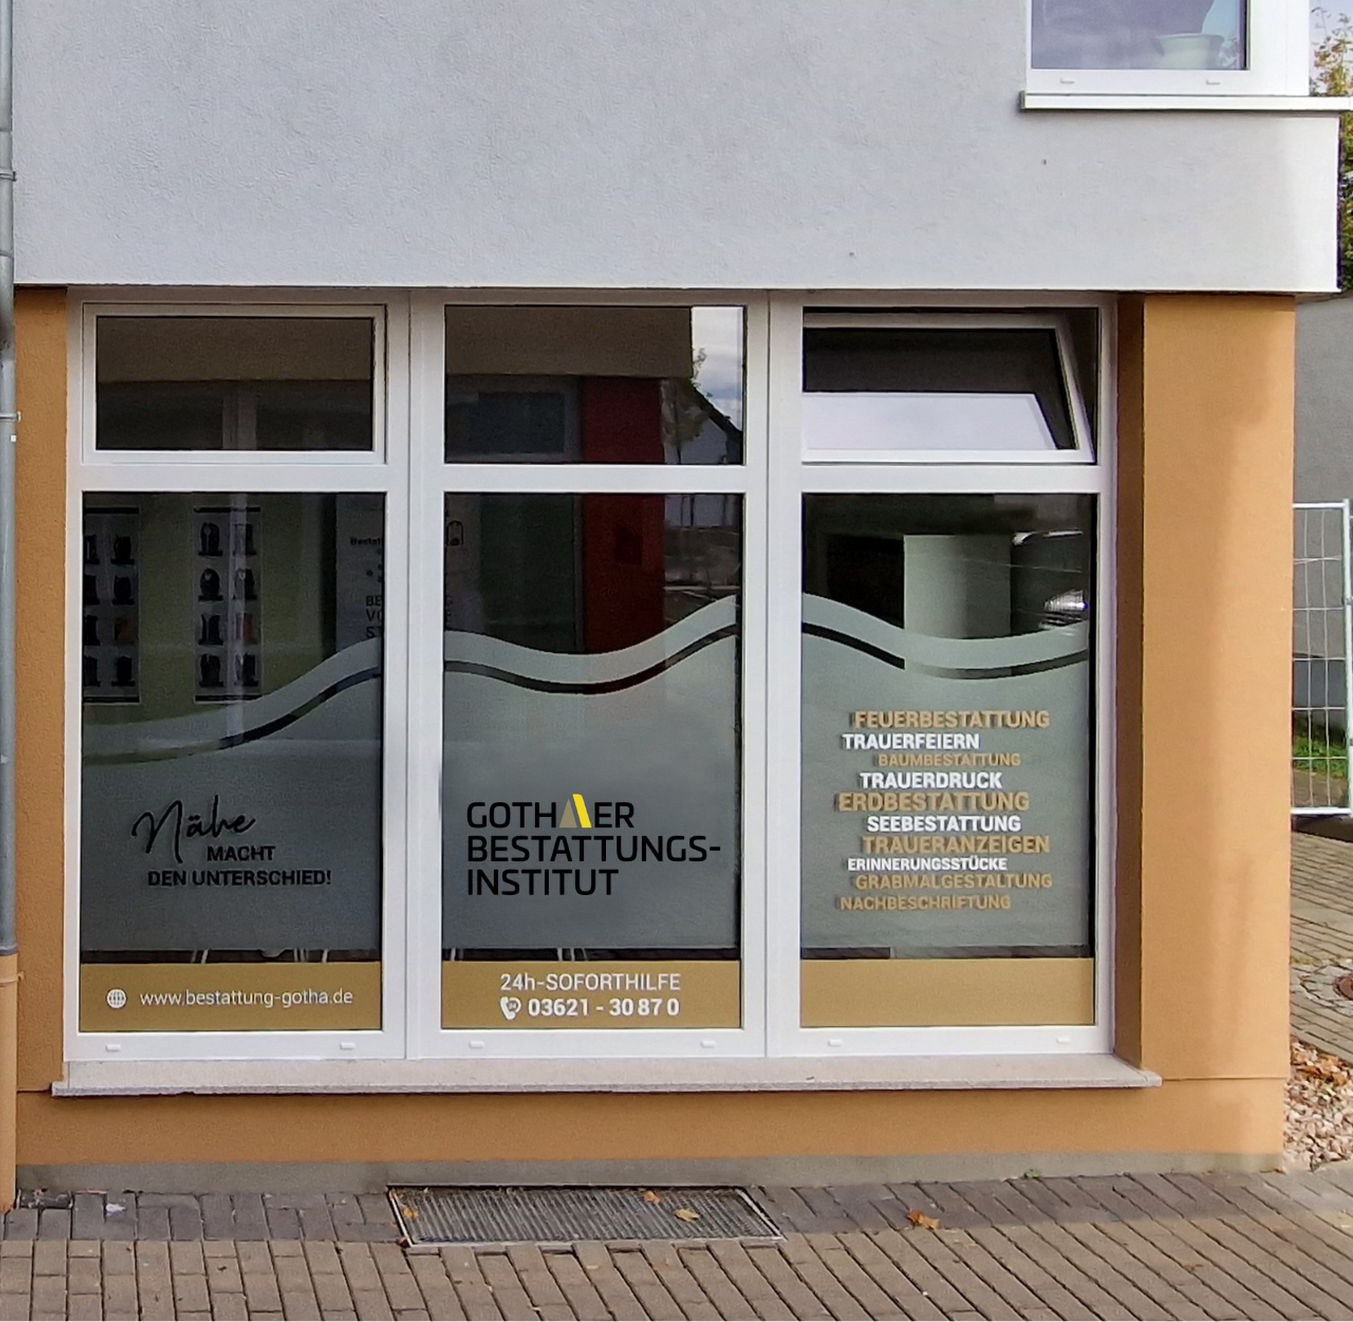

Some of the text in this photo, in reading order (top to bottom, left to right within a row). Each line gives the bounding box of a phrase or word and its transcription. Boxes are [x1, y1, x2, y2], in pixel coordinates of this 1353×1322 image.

[854, 711, 1050, 728] FEUERBESTATTUNG
[842, 733, 979, 750] TRAUERFEIERN
[878, 753, 1021, 767] BAUMBESTATTUNG
[860, 772, 1002, 789] TRAUERDRUCK
[838, 792, 1029, 811] ERDBESTATTUNG
[131, 795, 256, 863] Nähe
[867, 815, 1021, 832] SEEBESTATTUNG
[467, 836, 721, 862] BESTATTUNGS-
[862, 836, 1050, 853] TRAUERANZEIGEN
[207, 846, 276, 861] MACHT
[848, 856, 1007, 871] ERINNERUNGSSTÜCKE
[148, 870, 332, 886] DEN UNTERSCHIED!
[467, 869, 619, 896] INSTITUT
[855, 873, 1053, 890] GRABMALGESTALTUNG
[840, 895, 1011, 910] NACHBESCHRIFTUNG
[500, 973, 680, 991] 24h-SOFORTHILFE
[140, 989, 353, 1008] www.bestattung-gotha.de
[528, 998, 589, 1016] 03621
[609, 998, 634, 1016] 30
[637, 998, 663, 1016] 87
[666, 998, 680, 1016] 0
